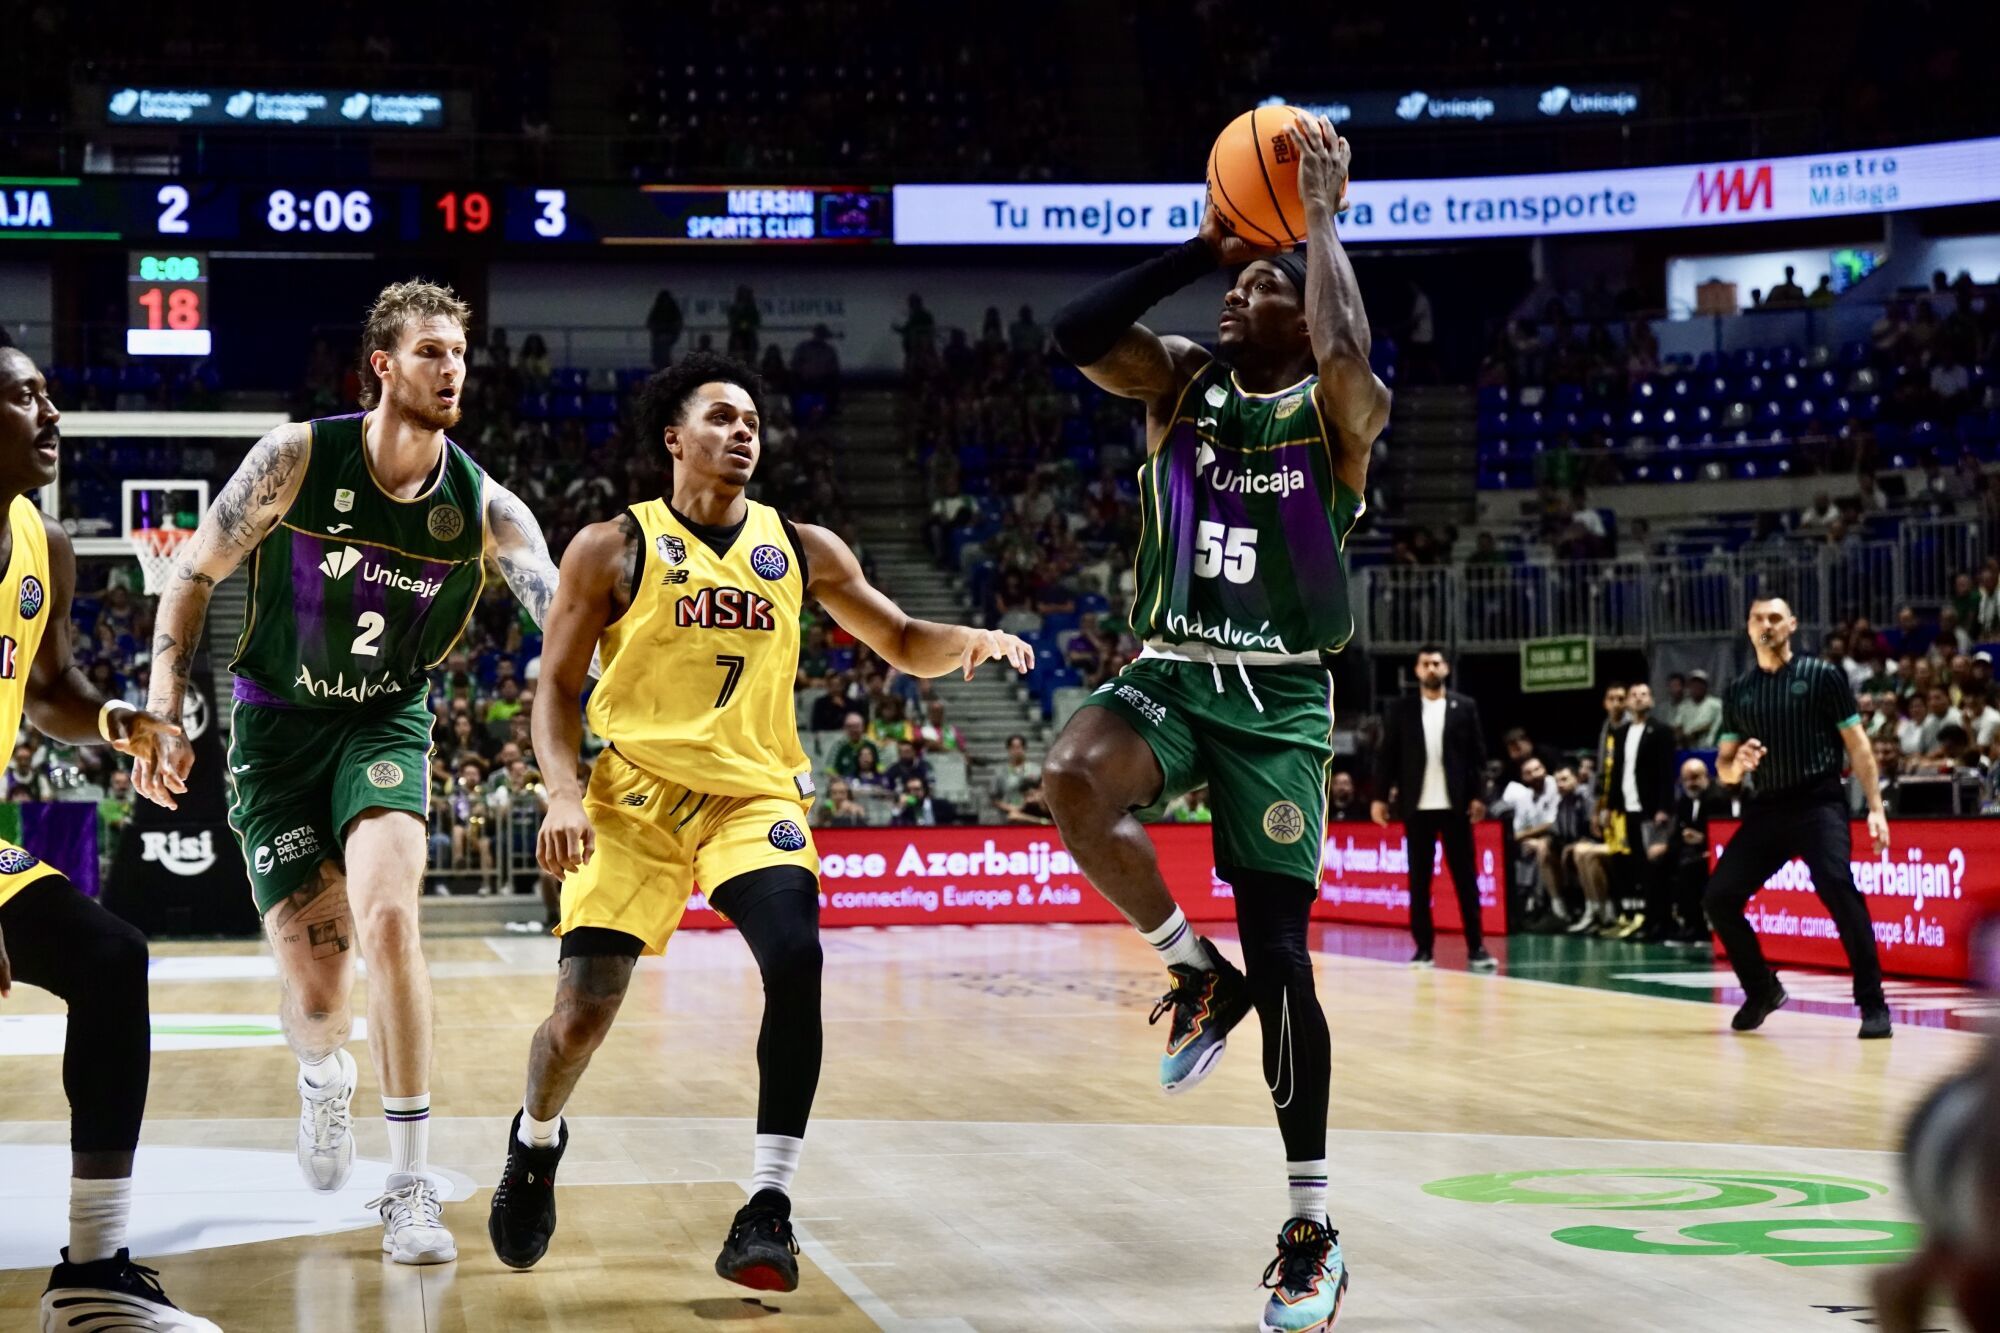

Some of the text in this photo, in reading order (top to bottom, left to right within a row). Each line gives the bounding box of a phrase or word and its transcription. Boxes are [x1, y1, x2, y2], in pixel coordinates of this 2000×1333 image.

[1272, 134, 1291, 165] FIBA
[1809, 156, 1898, 179] metro
[157, 185, 190, 234] 2
[267, 190, 373, 232] 8:06
[436, 192, 491, 233] 19
[534, 189, 567, 238] 3
[727, 190, 815, 215] MERSIN
[990, 199, 1028, 228] Tu
[1044, 199, 1153, 235] mejor
[1389, 195, 1431, 224] de
[1446, 188, 1638, 225] transporte
[1809, 182, 1900, 209] Málaga
[687, 215, 815, 238] SPORTS CLUB
[139, 256, 200, 281] 8:06
[139, 288, 200, 331] 18
[1211, 465, 1305, 498] Unicaja
[1194, 520, 1258, 584] 55
[363, 561, 443, 599] Unicaja
[675, 587, 775, 631] MSK
[350, 611, 386, 657] 2
[714, 655, 745, 709] 7
[1123, 684, 1167, 718] COSTA
[274, 825, 315, 846] COSTA
[276, 835, 319, 857] DEL SOL
[140, 831, 217, 876] Risi
[1850, 847, 1966, 912] zerbaijan?
[831, 886, 939, 912] connecting
[943, 885, 1013, 910] Europe
[1016, 883, 1034, 905] &
[1038, 883, 1082, 905] Asia
[1917, 916, 1946, 947] Asia
